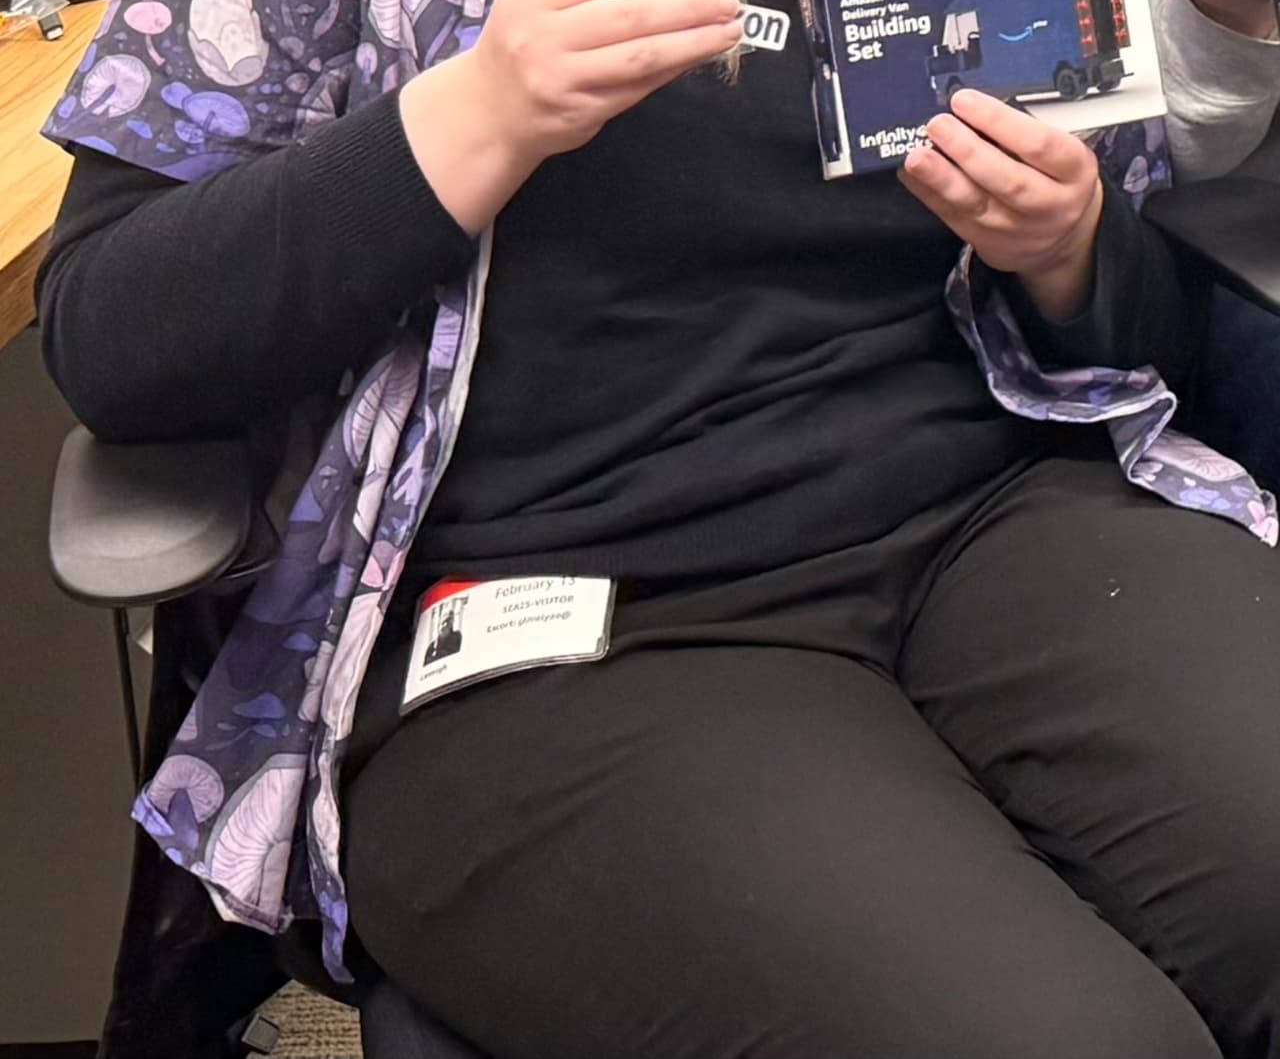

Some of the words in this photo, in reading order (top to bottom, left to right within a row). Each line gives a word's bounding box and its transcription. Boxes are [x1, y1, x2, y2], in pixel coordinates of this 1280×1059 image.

[845, 15, 931, 43] Building
[847, 41, 884, 63] Set
[859, 127, 916, 148] Infinity
[495, 579, 554, 599] February
